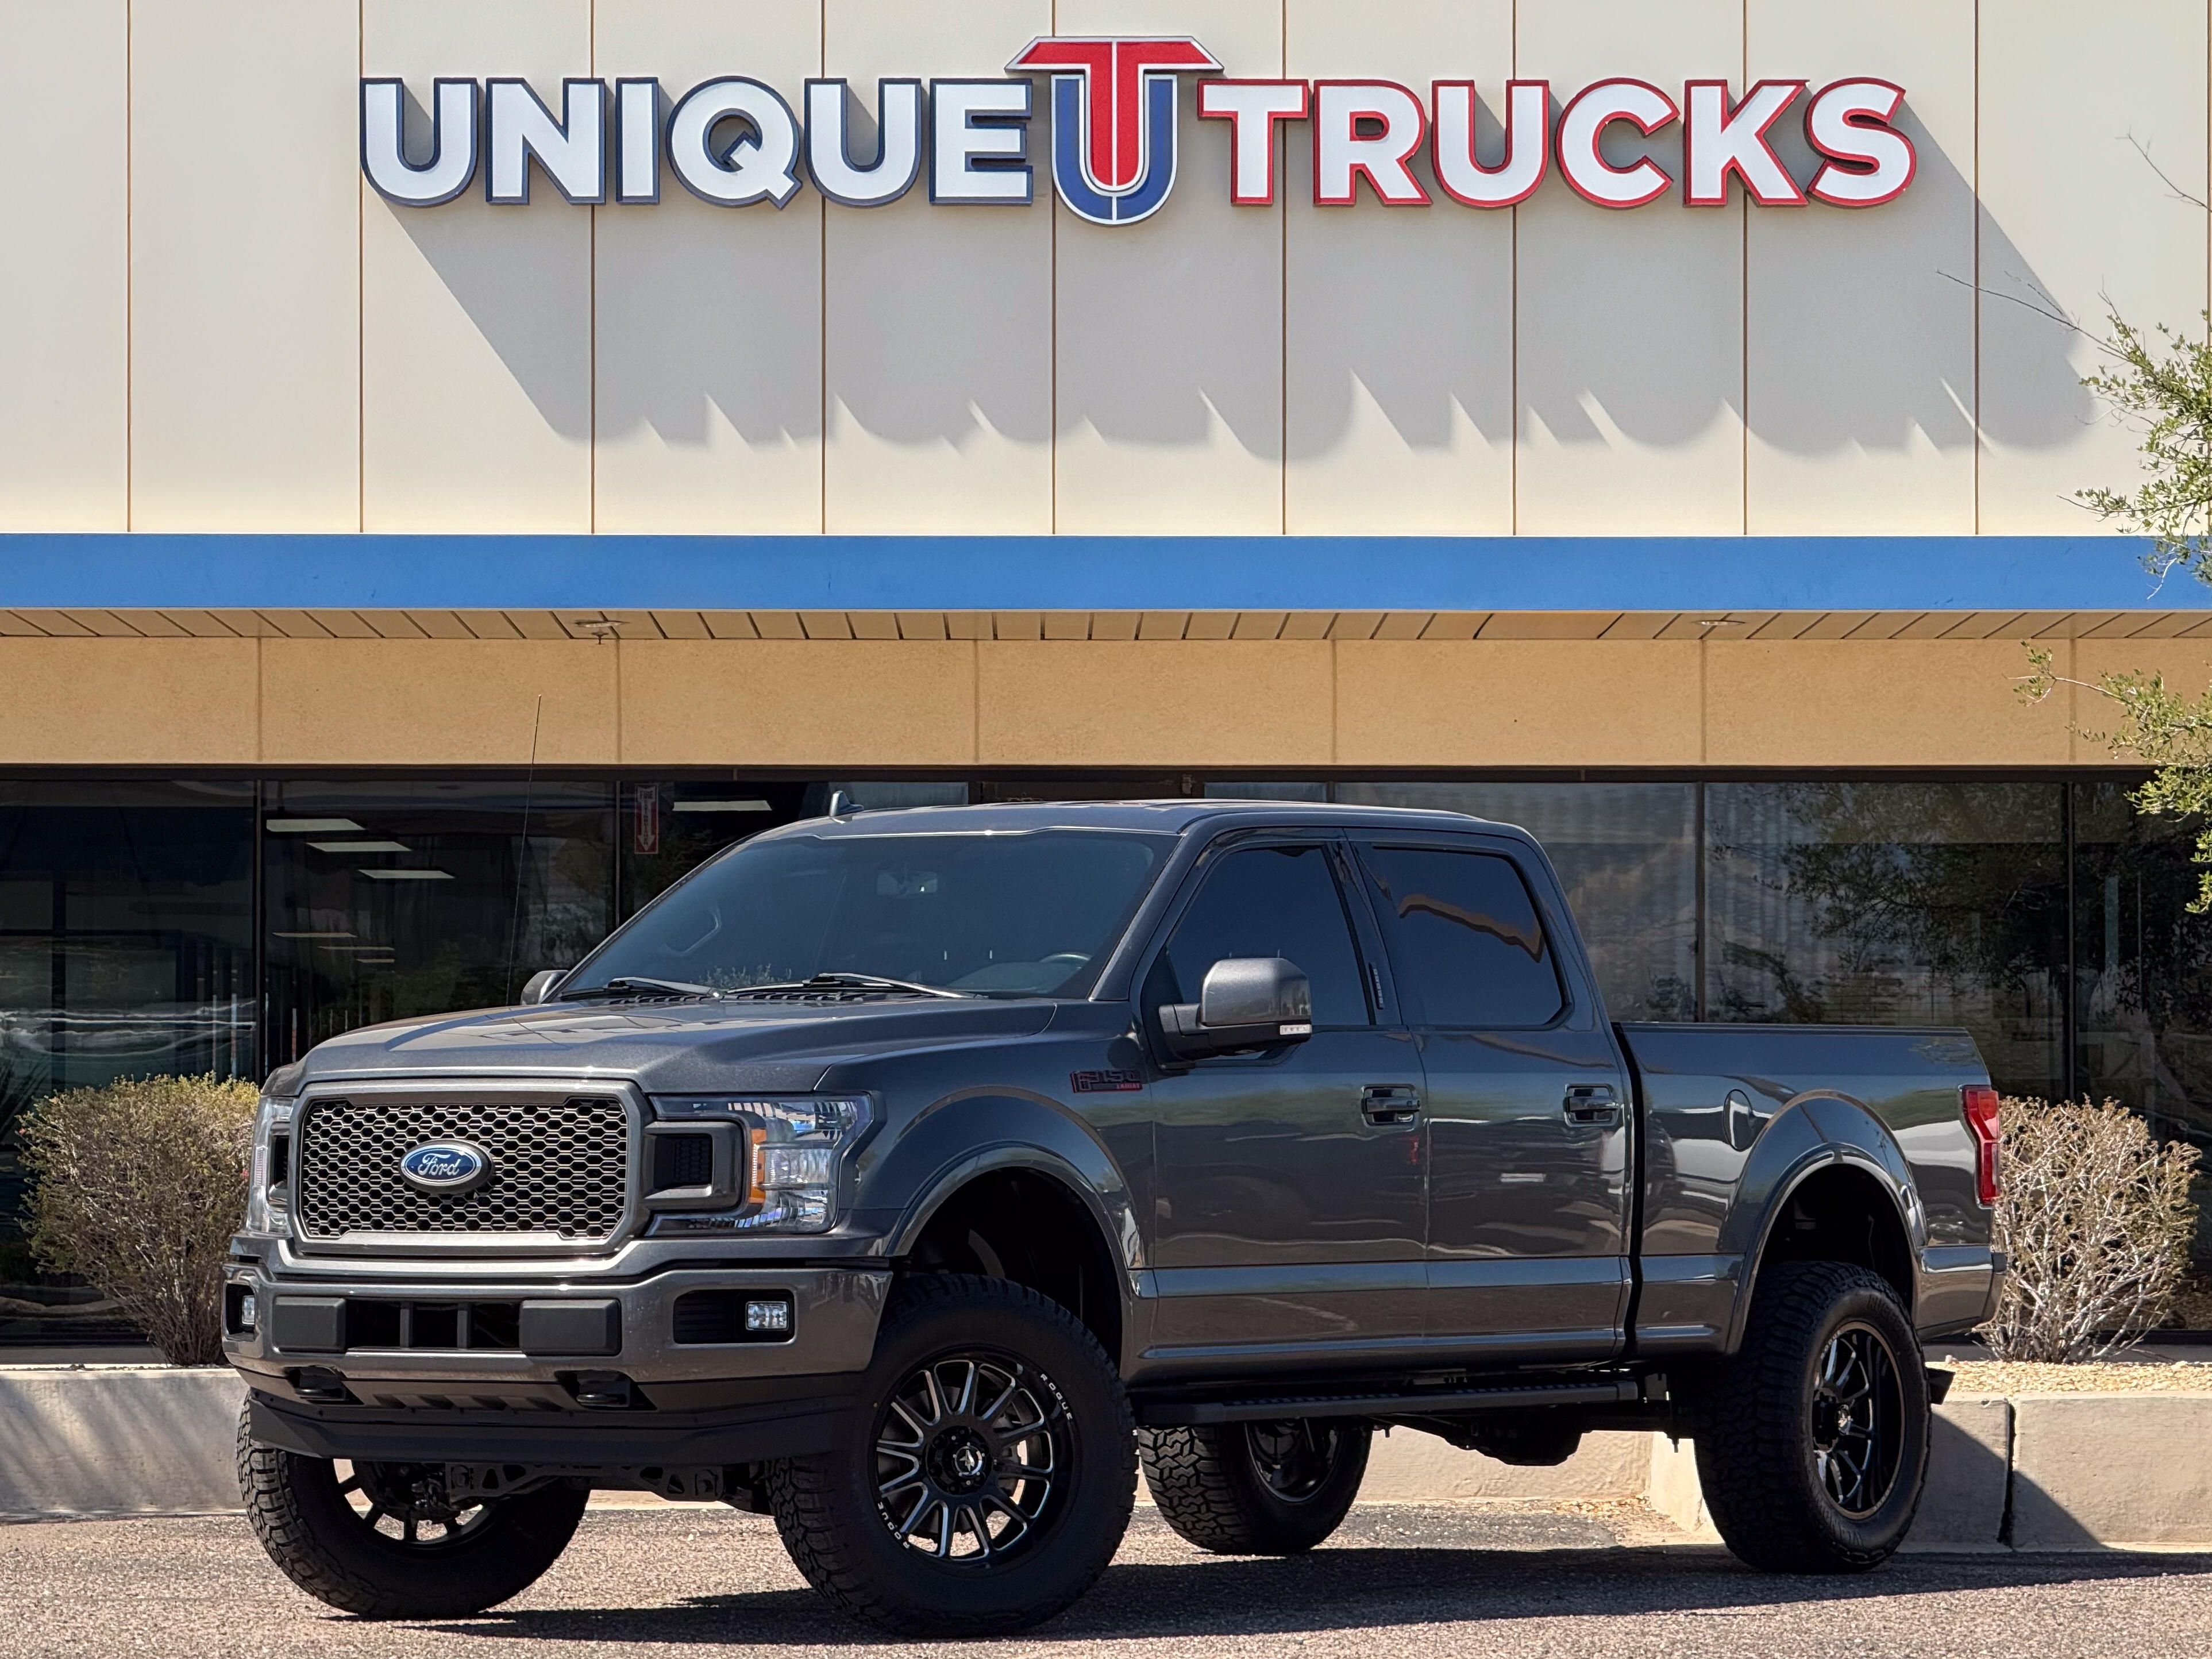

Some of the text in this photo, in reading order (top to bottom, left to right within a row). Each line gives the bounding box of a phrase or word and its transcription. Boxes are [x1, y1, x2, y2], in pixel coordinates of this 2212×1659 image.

[360, 75, 1033, 210] UNIQUE
[1197, 76, 1917, 209] TRUCKS
[639, 790, 653, 799] FIRE
[417, 1153, 461, 1176] Ford
[1041, 1373, 1073, 1420] ROGUE
[878, 1502, 910, 1549] ROGUE
